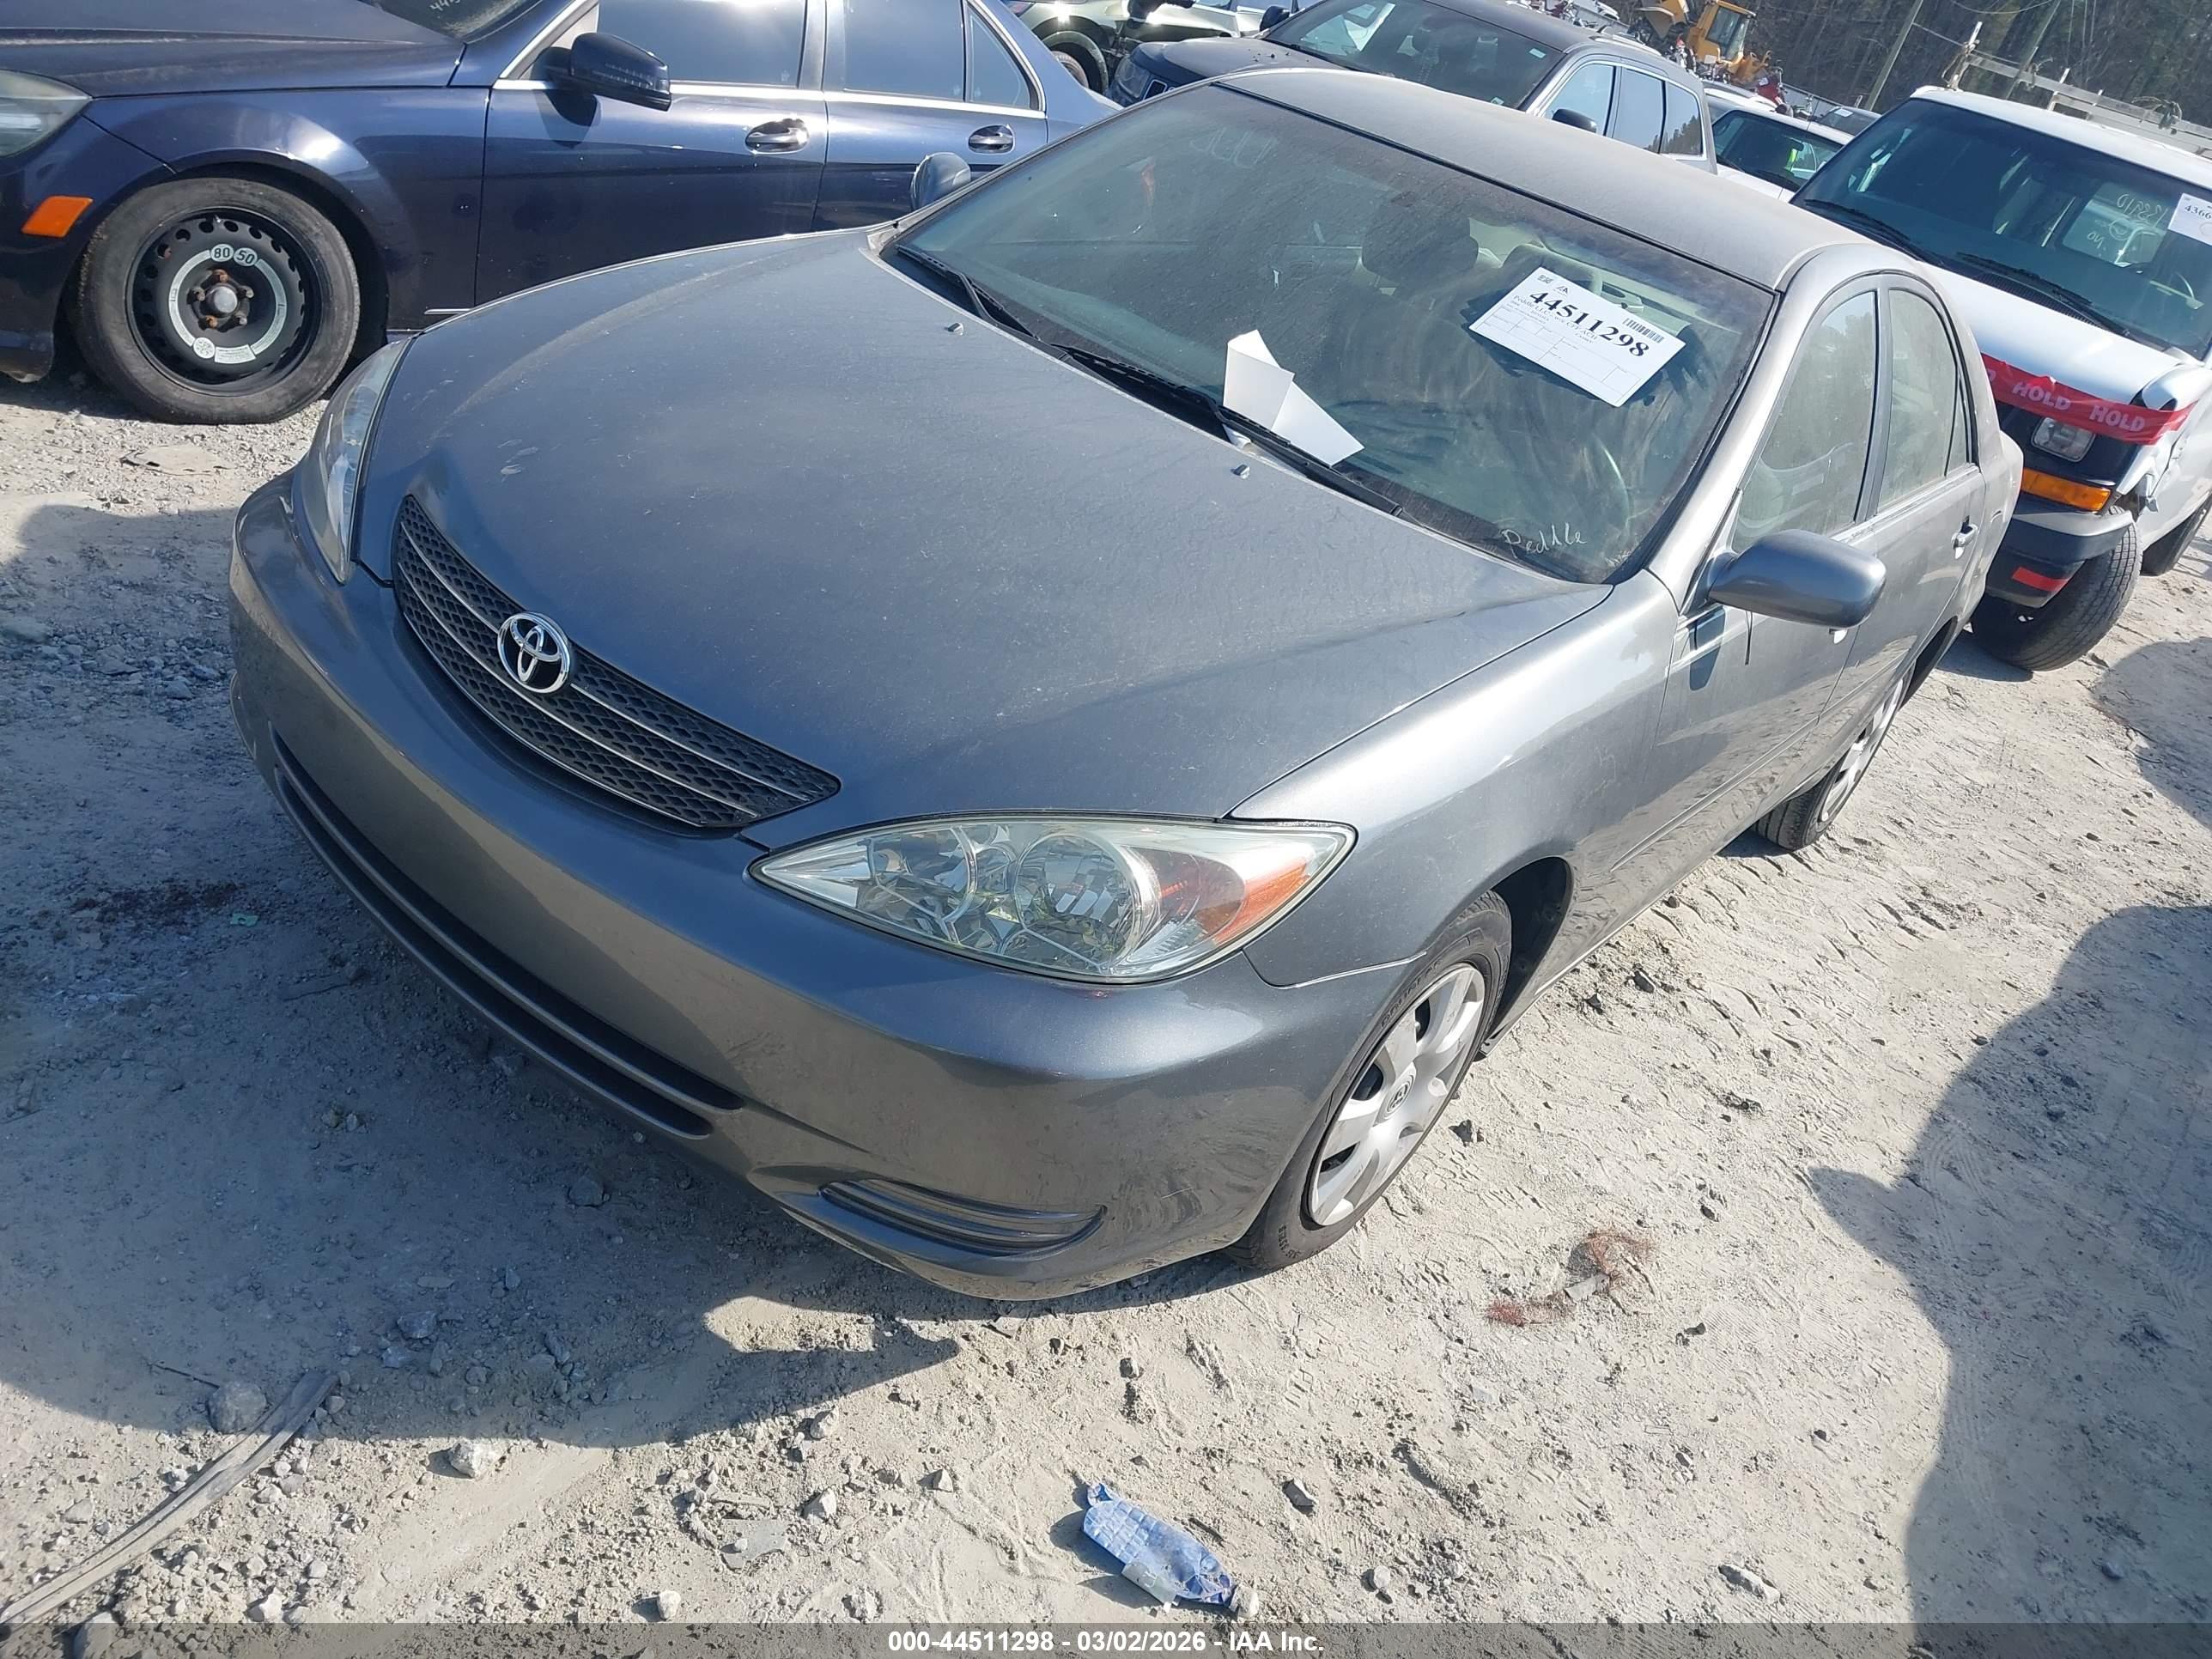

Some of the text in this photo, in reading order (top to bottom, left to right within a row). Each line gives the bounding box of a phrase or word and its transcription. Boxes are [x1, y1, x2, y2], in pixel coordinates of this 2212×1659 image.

[214, 247, 255, 264] 80 50
[1529, 291, 1650, 357] 44511298
[2012, 381, 2146, 432] HOLD HOLD
